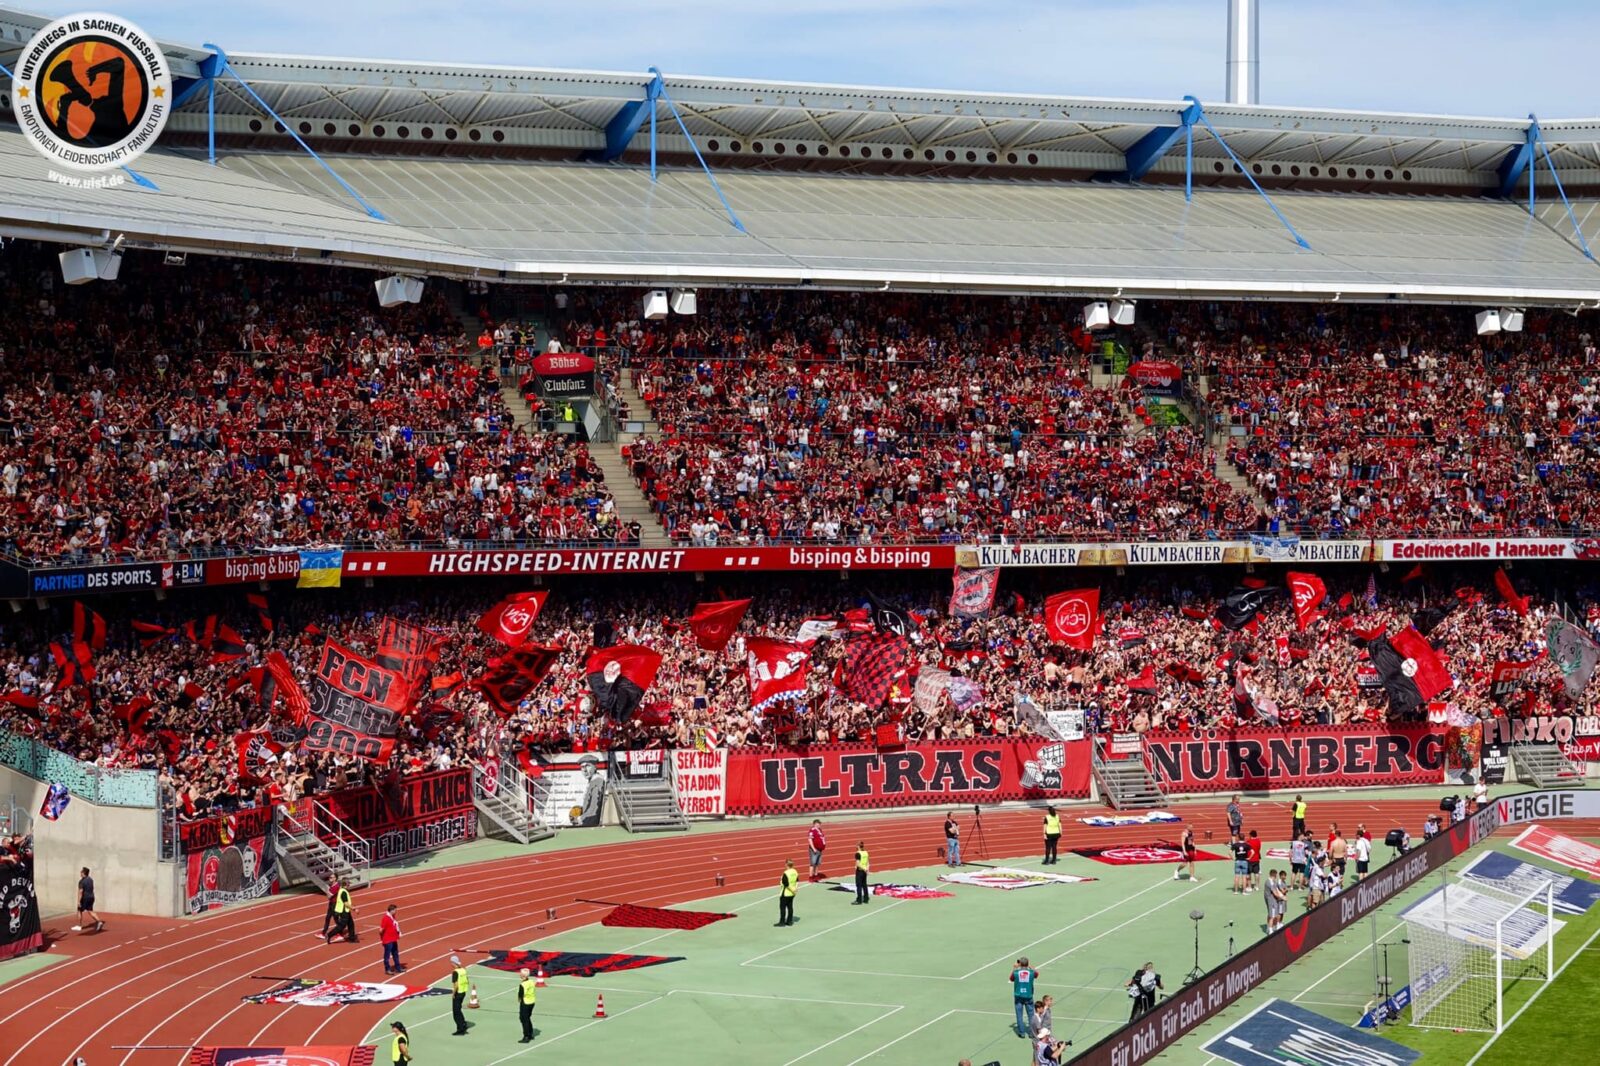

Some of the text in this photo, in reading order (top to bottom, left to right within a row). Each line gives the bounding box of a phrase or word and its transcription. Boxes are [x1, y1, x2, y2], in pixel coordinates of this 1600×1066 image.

[790, 547, 931, 569] bisping & bisping
[981, 547, 1076, 565] KULMBACHER
[1129, 544, 1221, 562] KULMBACHER
[1300, 544, 1360, 560] MBACHER
[1393, 541, 1566, 559] Edelmetalle Hanauer
[268, 556, 277, 575] &
[278, 555, 300, 578] bisp
[429, 550, 686, 573] HIGHSPEED-INTERNET
[34, 574, 85, 591] PARTNER
[87, 572, 108, 588] DES
[321, 646, 394, 705] FCN
[309, 677, 394, 736] SEIT
[304, 719, 383, 759] 900
[630, 749, 662, 762] RESPEKT
[677, 752, 722, 770] SEKTION
[1150, 730, 1446, 783] NÜRNBERG
[678, 774, 721, 791] STADION
[760, 750, 1001, 802] ULTRAS
[420, 771, 473, 813] AMICI
[679, 796, 721, 815] VERBOT
[1341, 897, 1356, 924] Der
[1357, 875, 1393, 912] Ökostrom
[1394, 868, 1404, 890] der
[1111, 960, 1262, 1066] Für Dich. Für Euch. Für Morgen.
